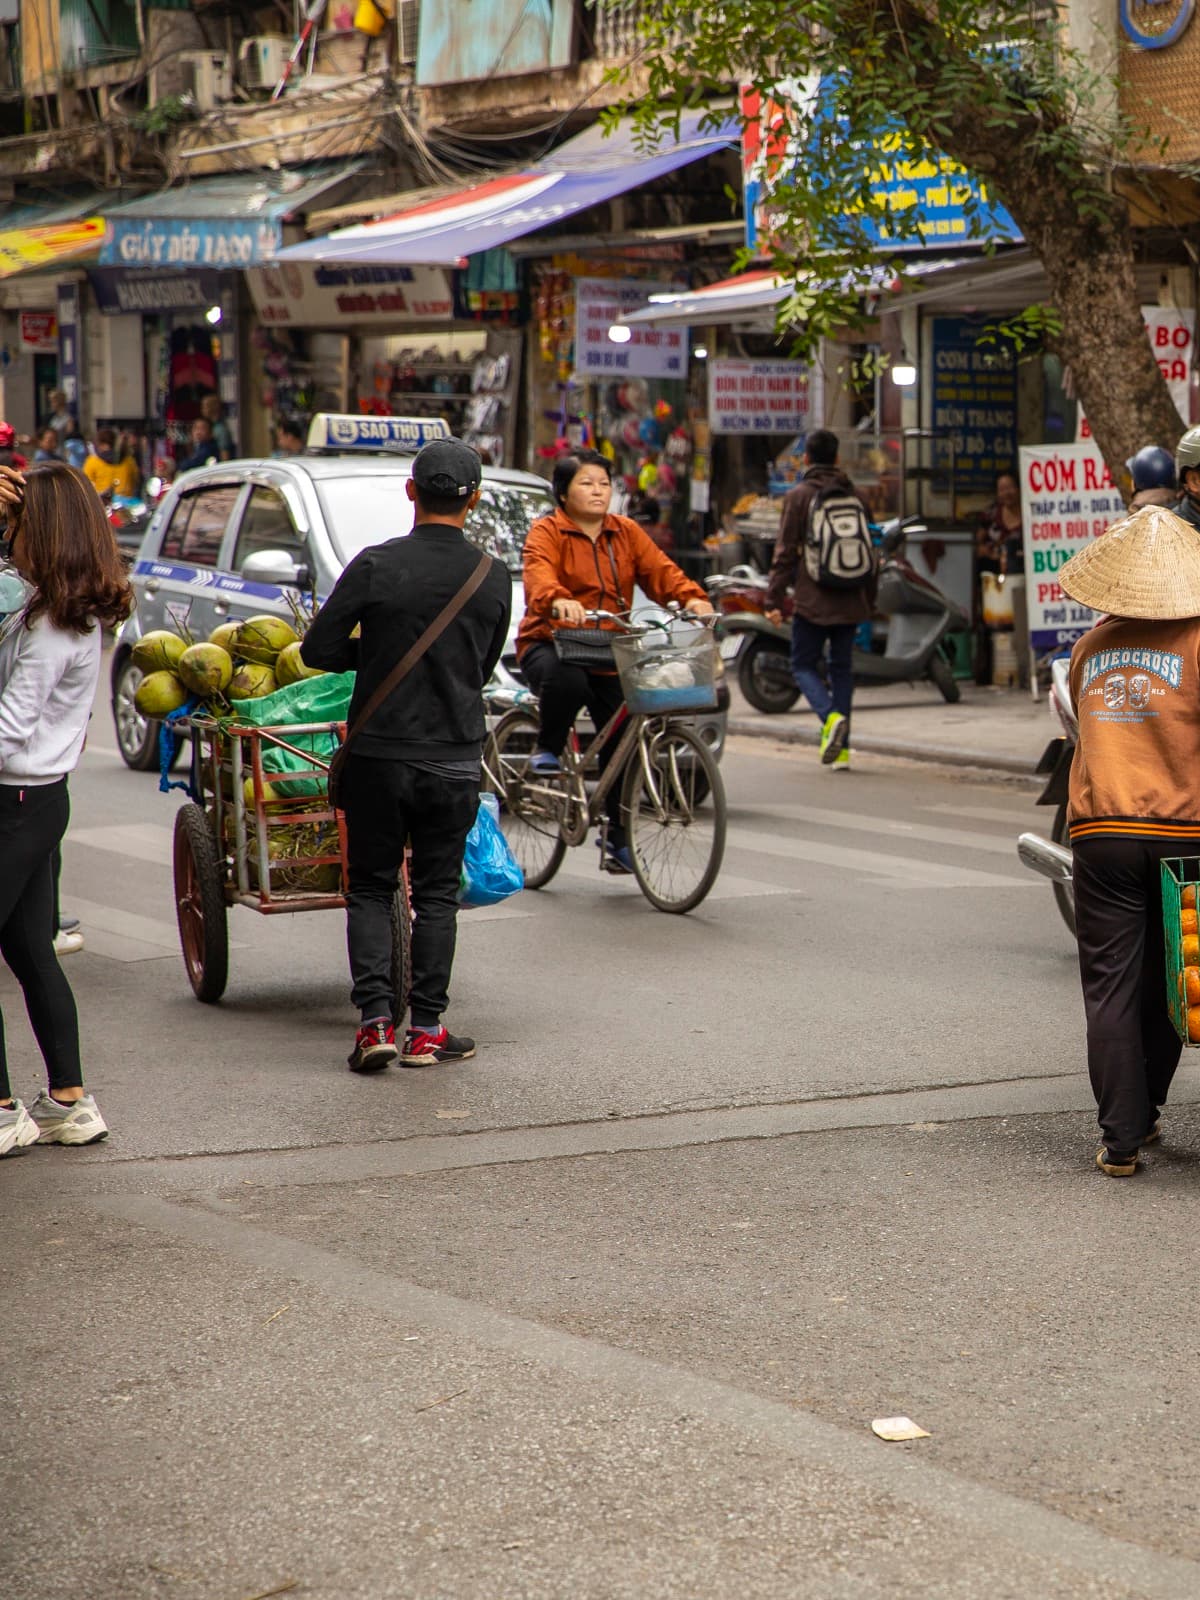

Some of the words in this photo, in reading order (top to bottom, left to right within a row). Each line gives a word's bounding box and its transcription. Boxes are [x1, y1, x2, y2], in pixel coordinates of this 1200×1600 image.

[1155, 320, 1191, 348] BÒ
[360, 422, 389, 439] SAO
[1029, 453, 1077, 493] CƠM
[1083, 457, 1116, 491] RA
[1031, 519, 1061, 541] CƠM
[1038, 582, 1062, 604] PH
[1081, 650, 1180, 693] BLUEOCROSS
